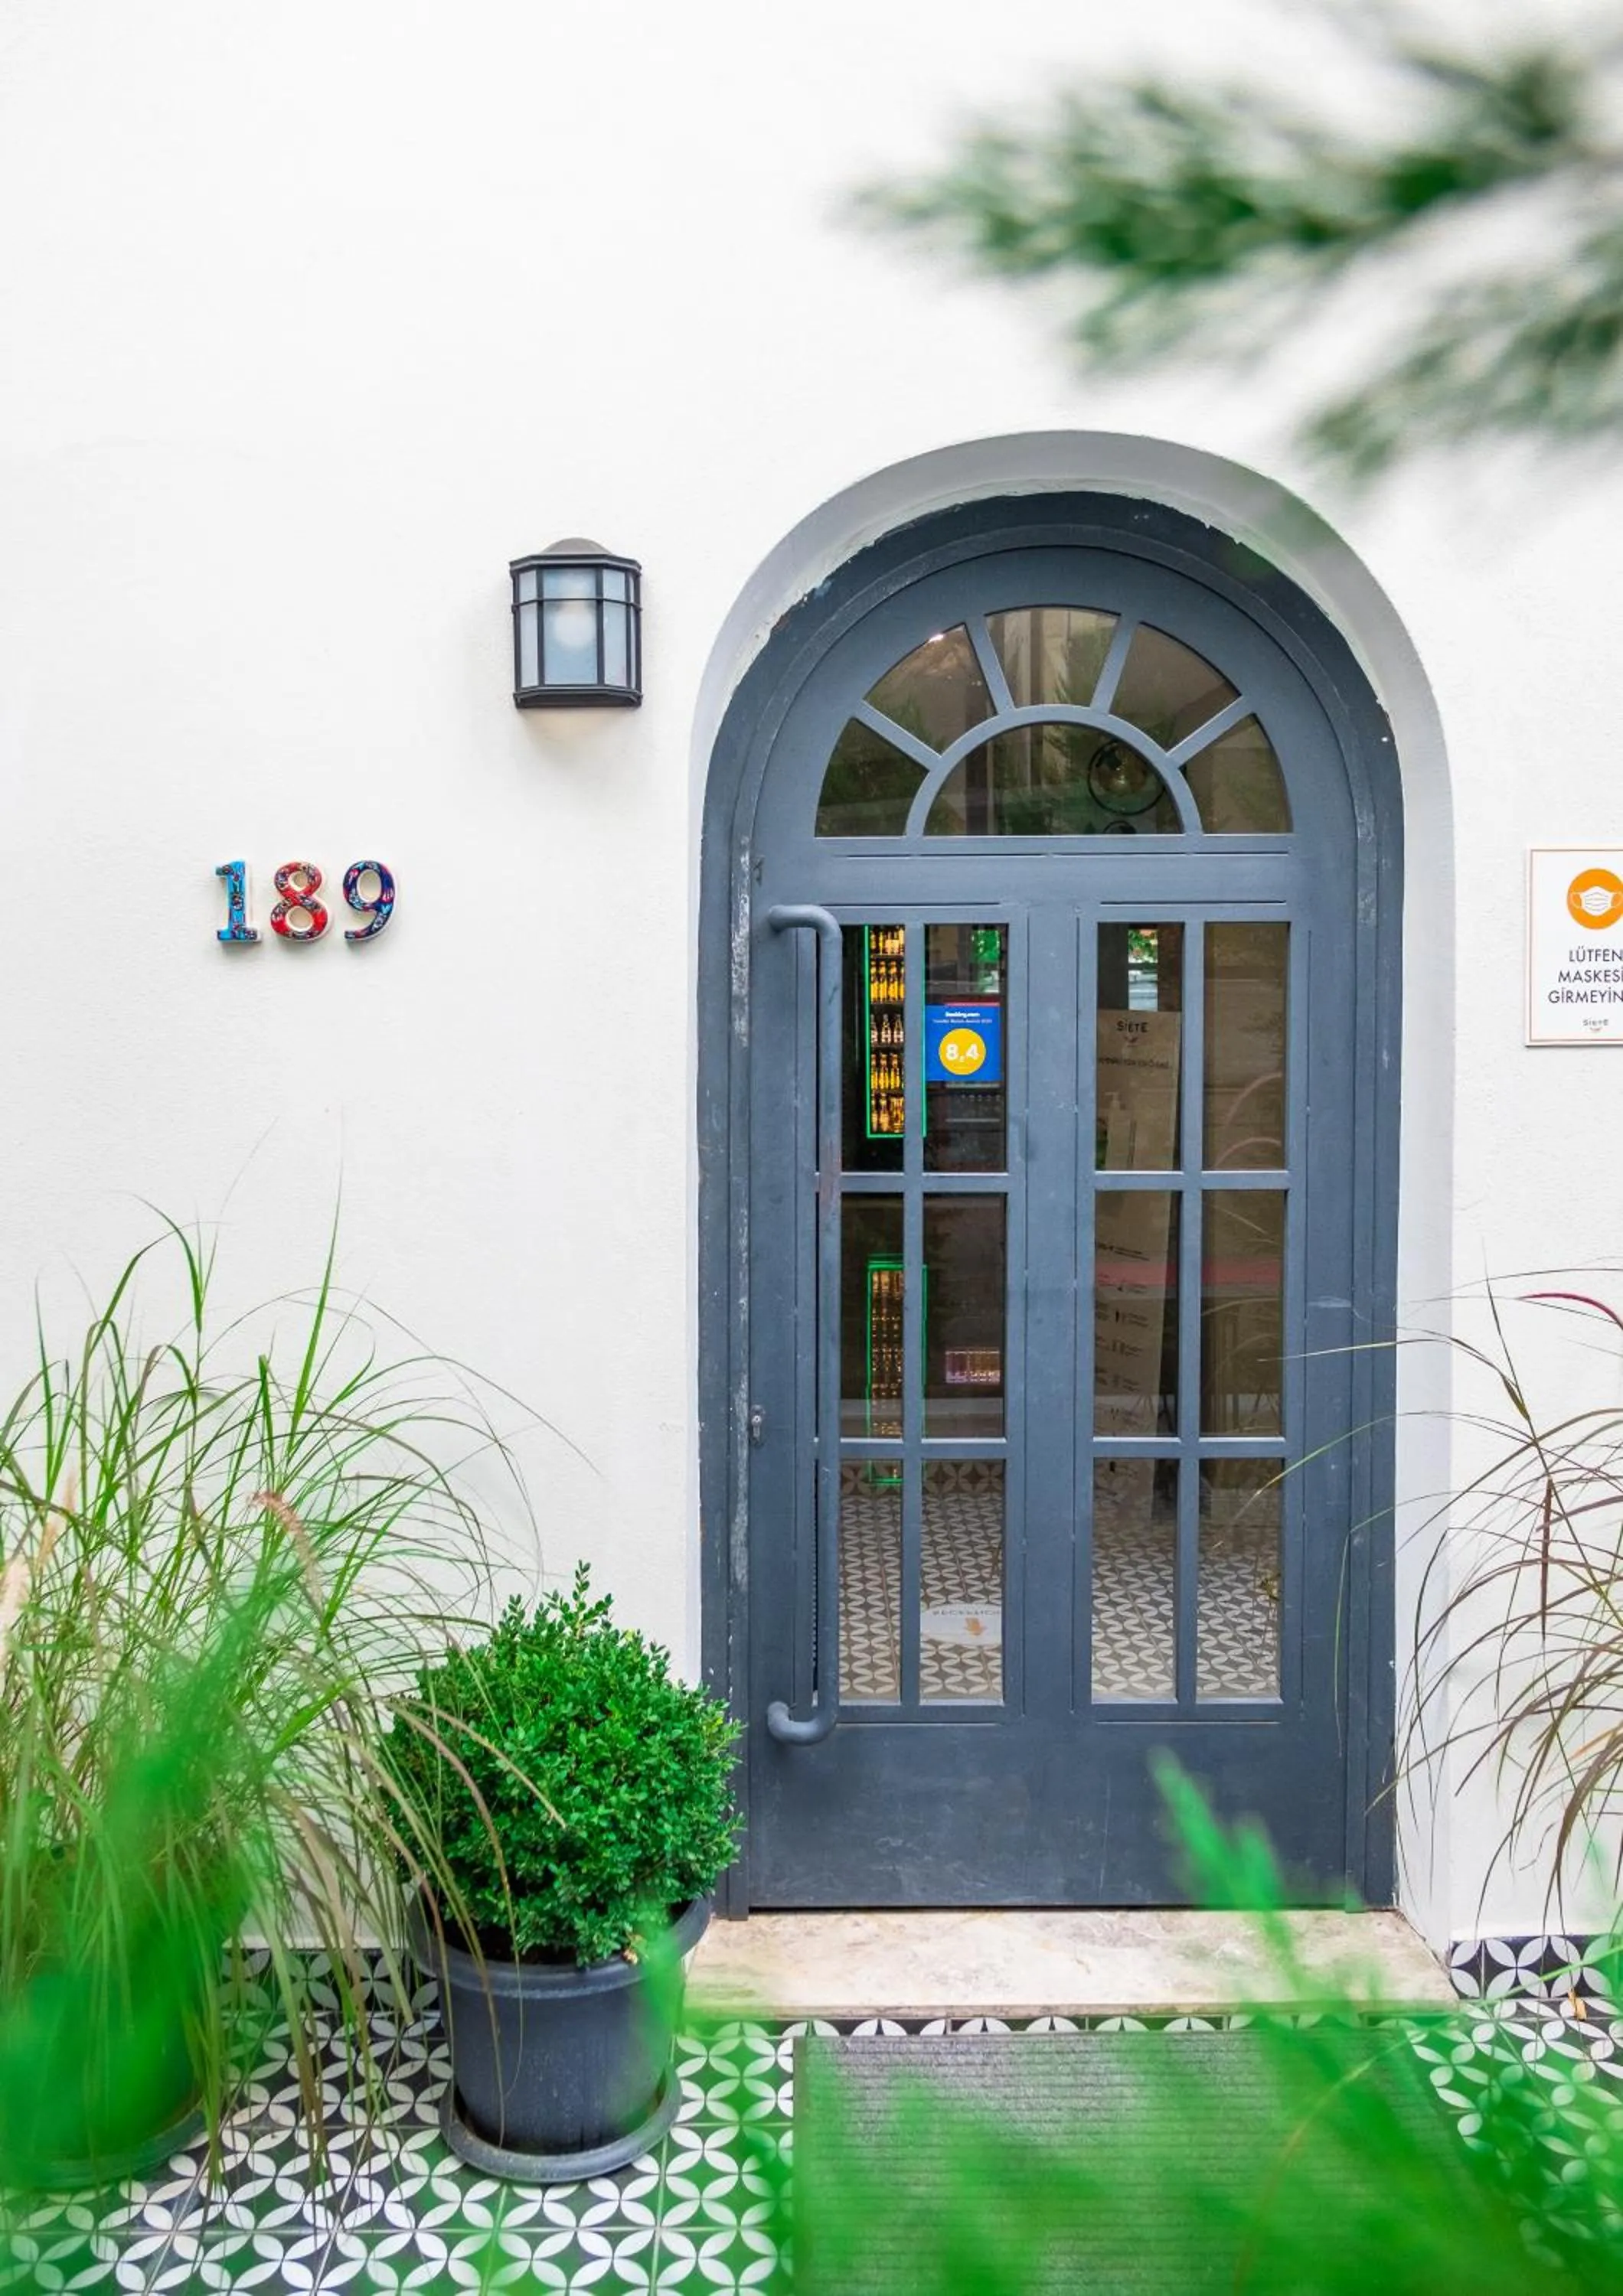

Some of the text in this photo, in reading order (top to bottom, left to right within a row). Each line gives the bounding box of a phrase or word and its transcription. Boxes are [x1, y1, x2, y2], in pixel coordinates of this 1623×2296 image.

[215, 859, 397, 942] 189
[1569, 945, 1623, 962] LÜTFEN
[1548, 987, 1623, 1003] GİRMEYİN
